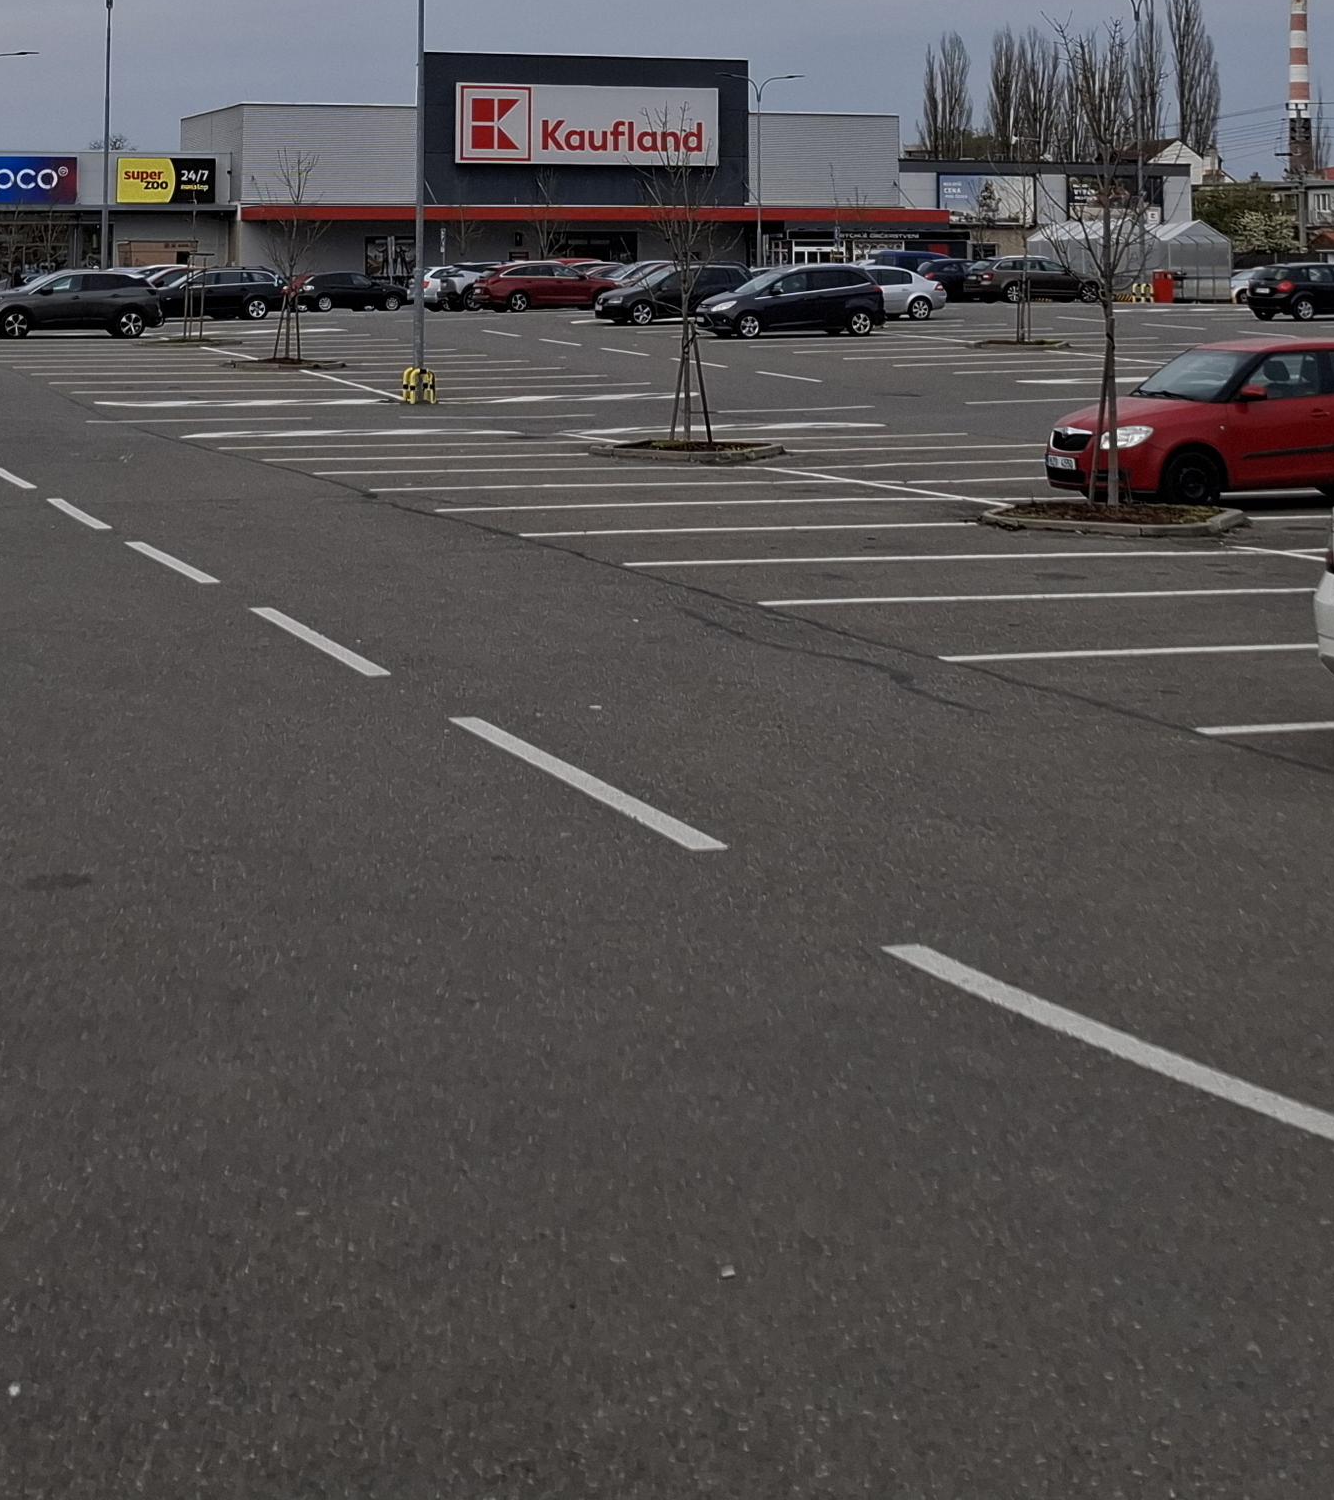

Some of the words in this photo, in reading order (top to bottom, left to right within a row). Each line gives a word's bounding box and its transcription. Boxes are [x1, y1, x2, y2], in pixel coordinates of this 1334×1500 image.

[541, 118, 703, 153] Kaufland
[123, 170, 164, 183] super
[180, 169, 209, 182] 24/7
[144, 180, 169, 190] zoo
